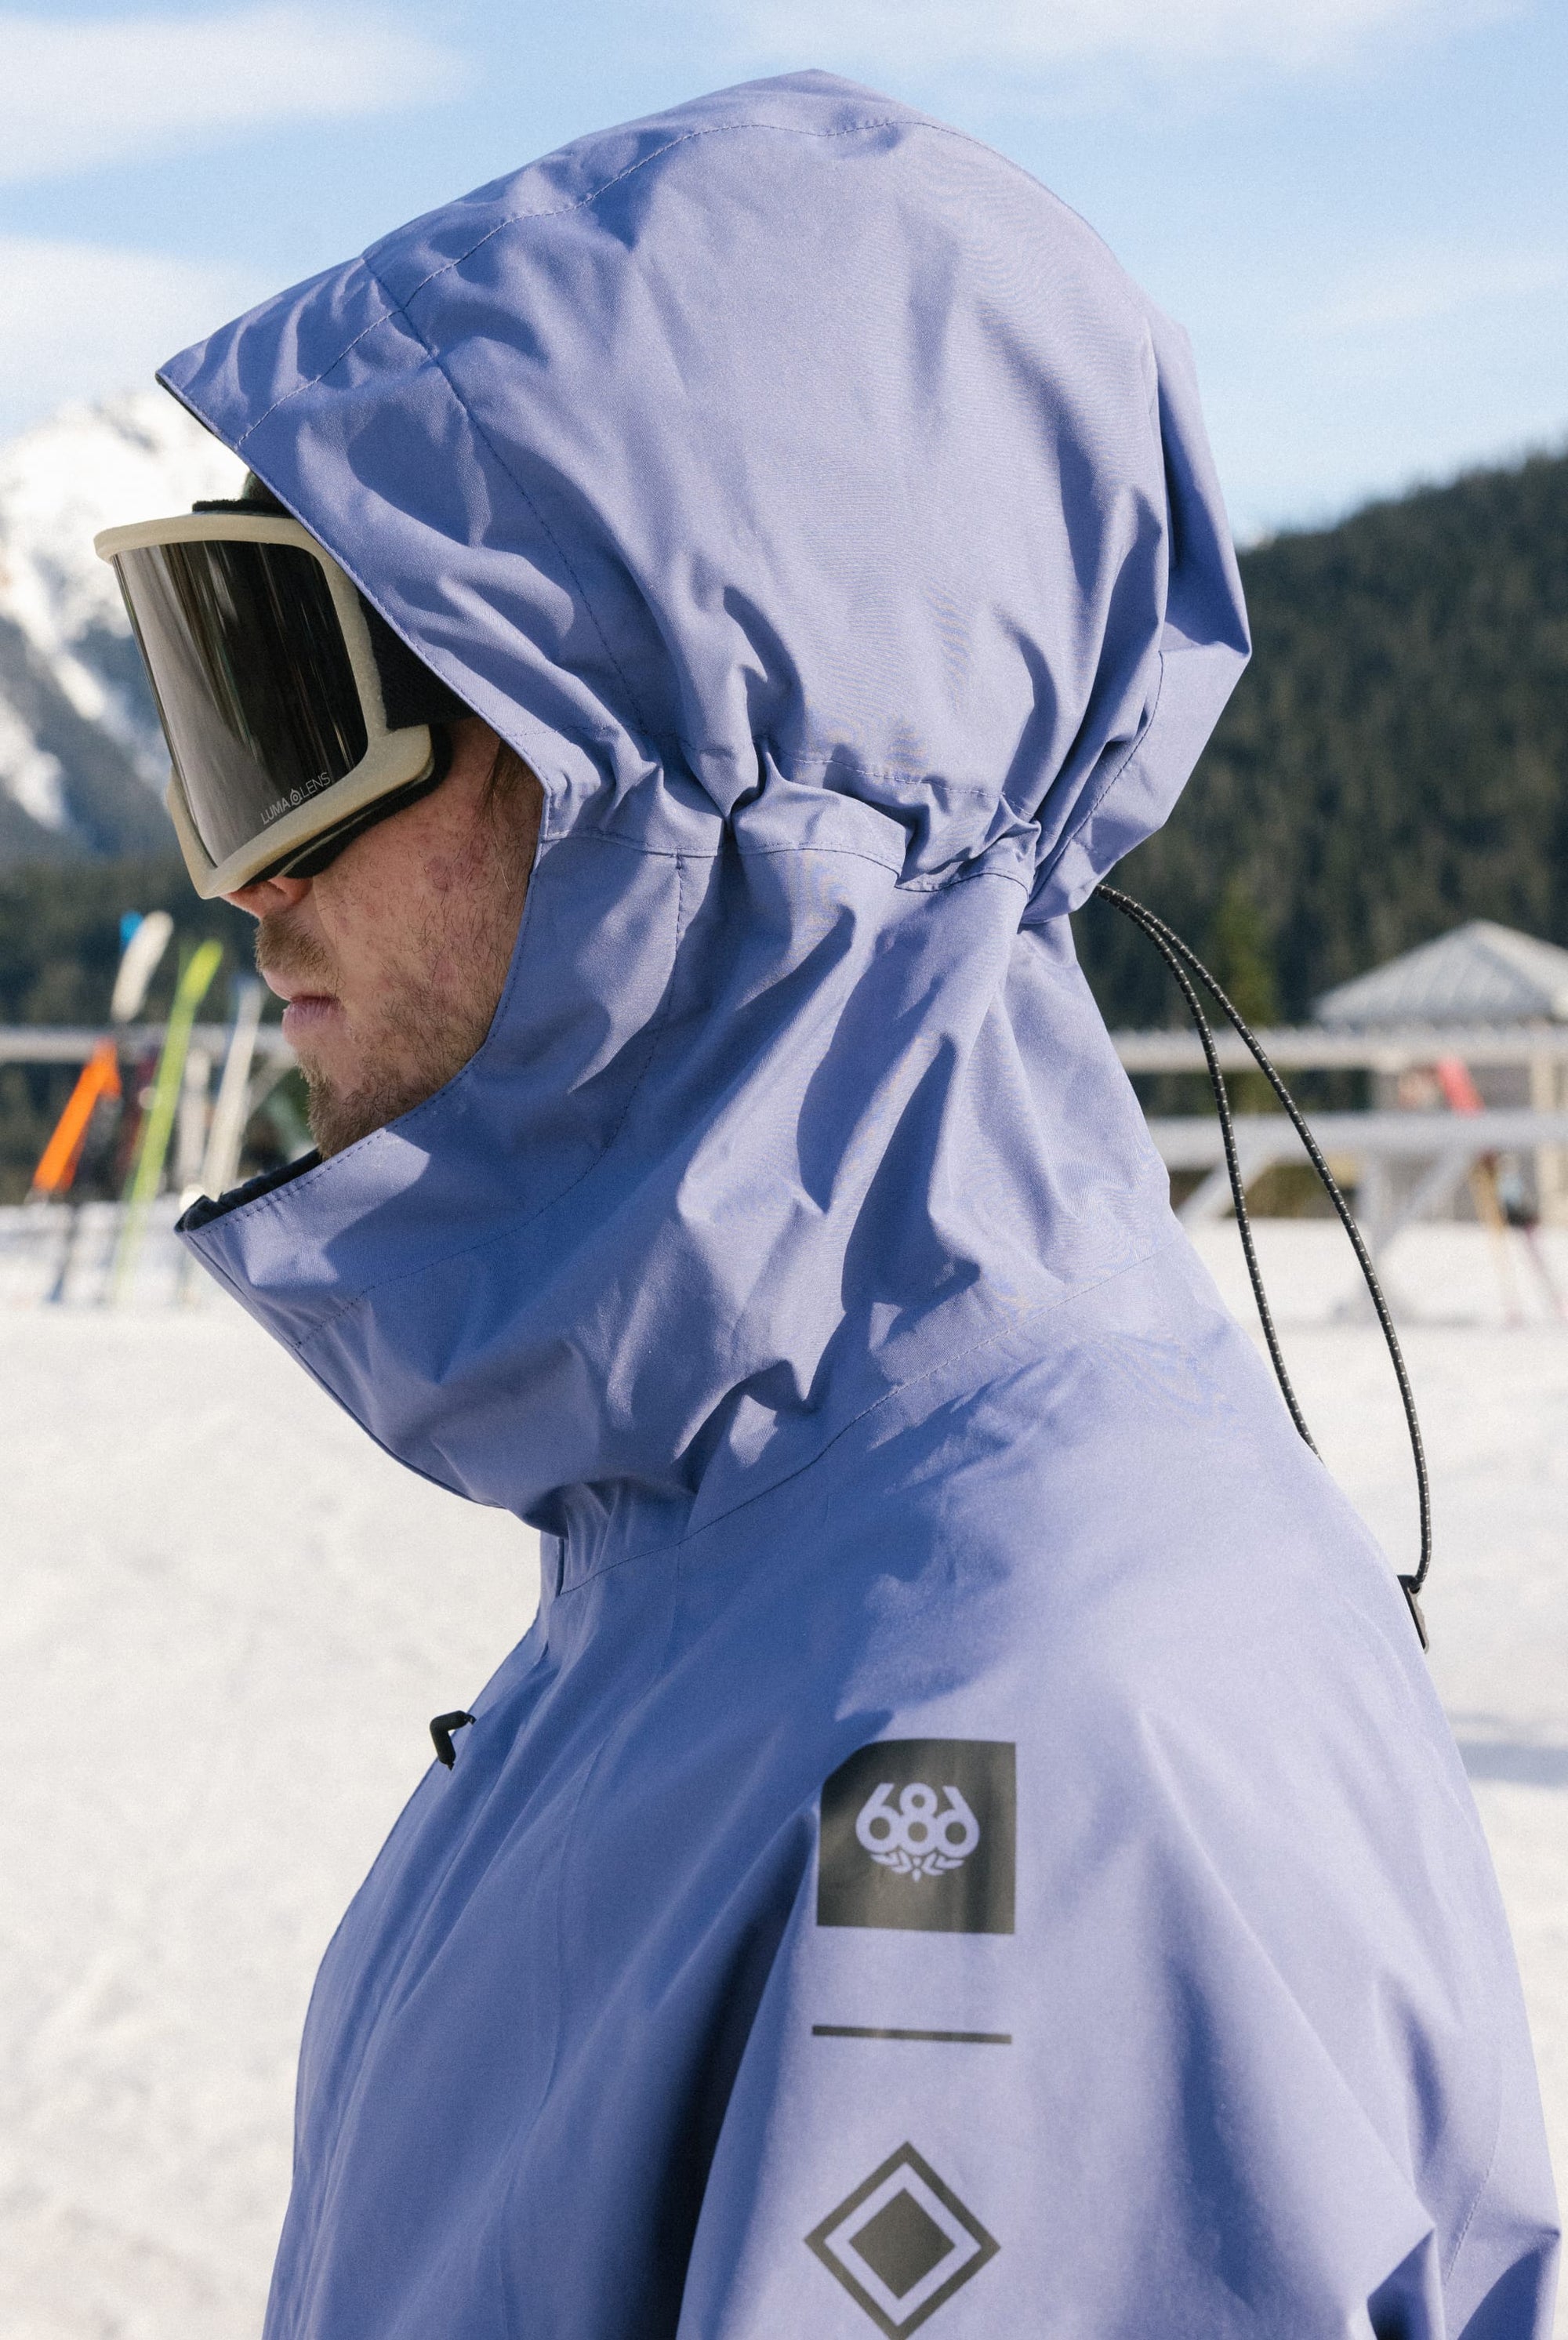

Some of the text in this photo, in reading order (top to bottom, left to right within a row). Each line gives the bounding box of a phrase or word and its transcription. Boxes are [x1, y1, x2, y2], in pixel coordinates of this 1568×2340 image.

[260, 772, 331, 825] LUMA LENS
[855, 1783, 980, 1858] 686
